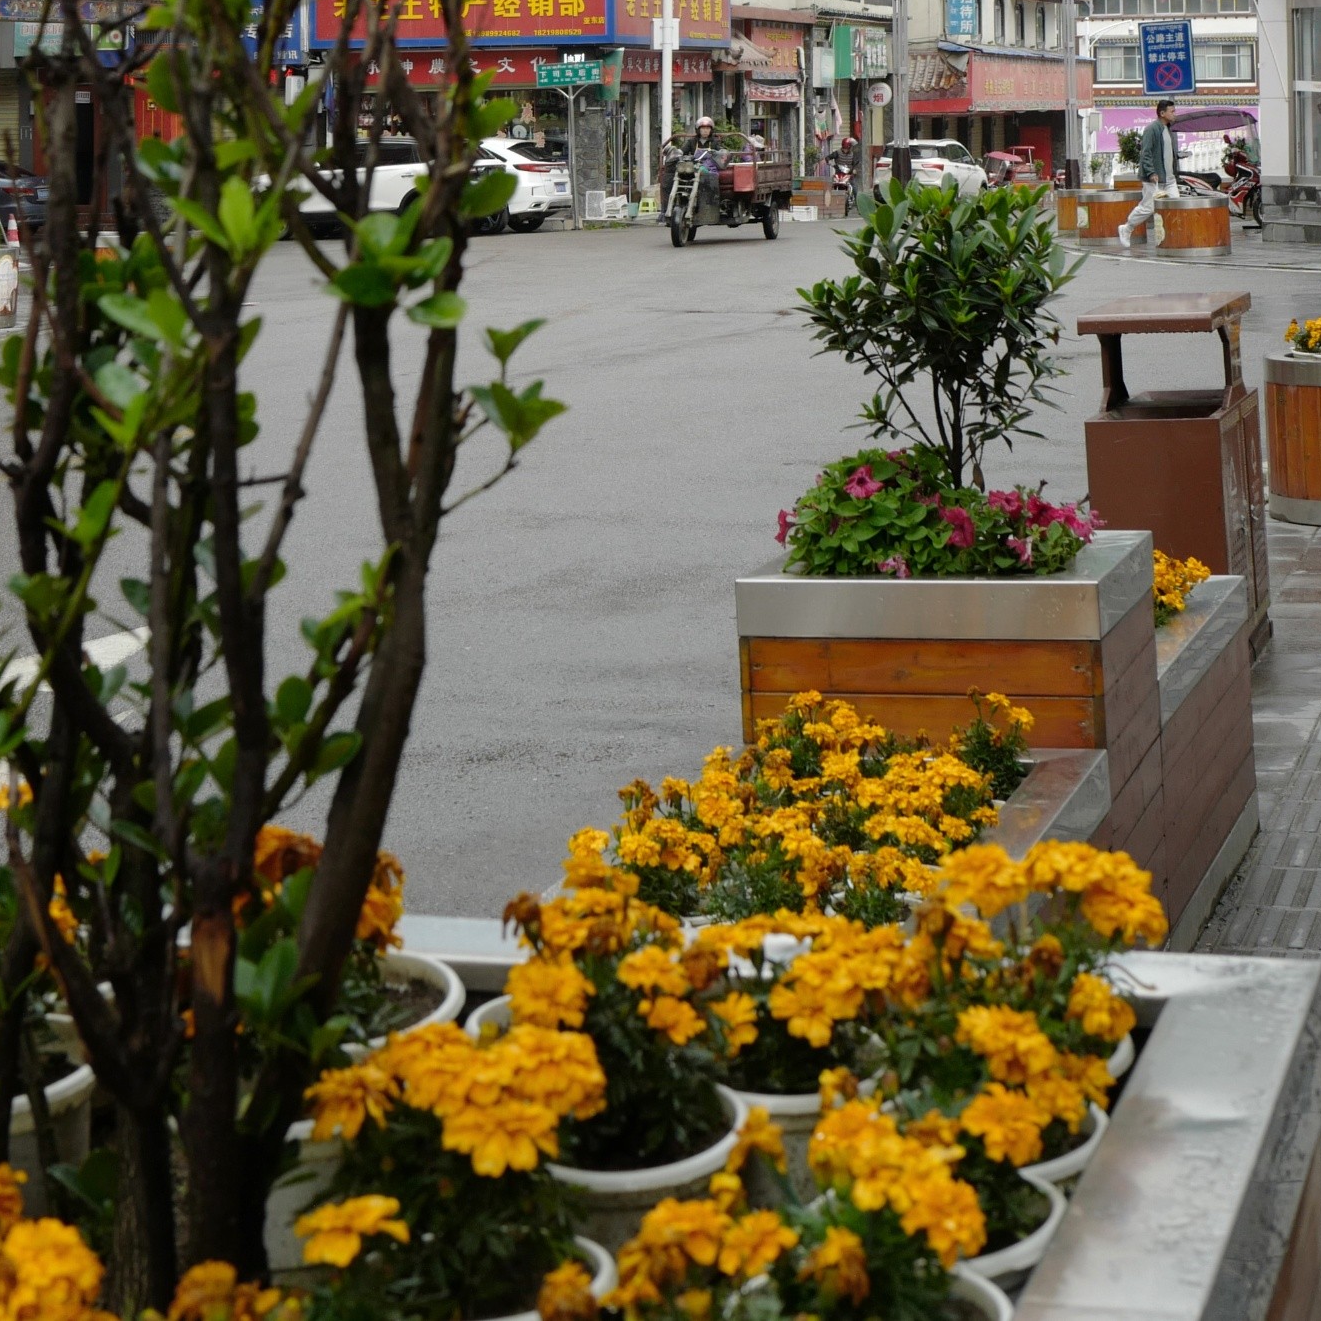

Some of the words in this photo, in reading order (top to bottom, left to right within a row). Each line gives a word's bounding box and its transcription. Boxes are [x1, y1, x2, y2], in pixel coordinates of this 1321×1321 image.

[1146, 32, 1184, 44] 公路主道
[1148, 51, 1186, 62] 禁止停车
[873, 94, 884, 103] 烟
